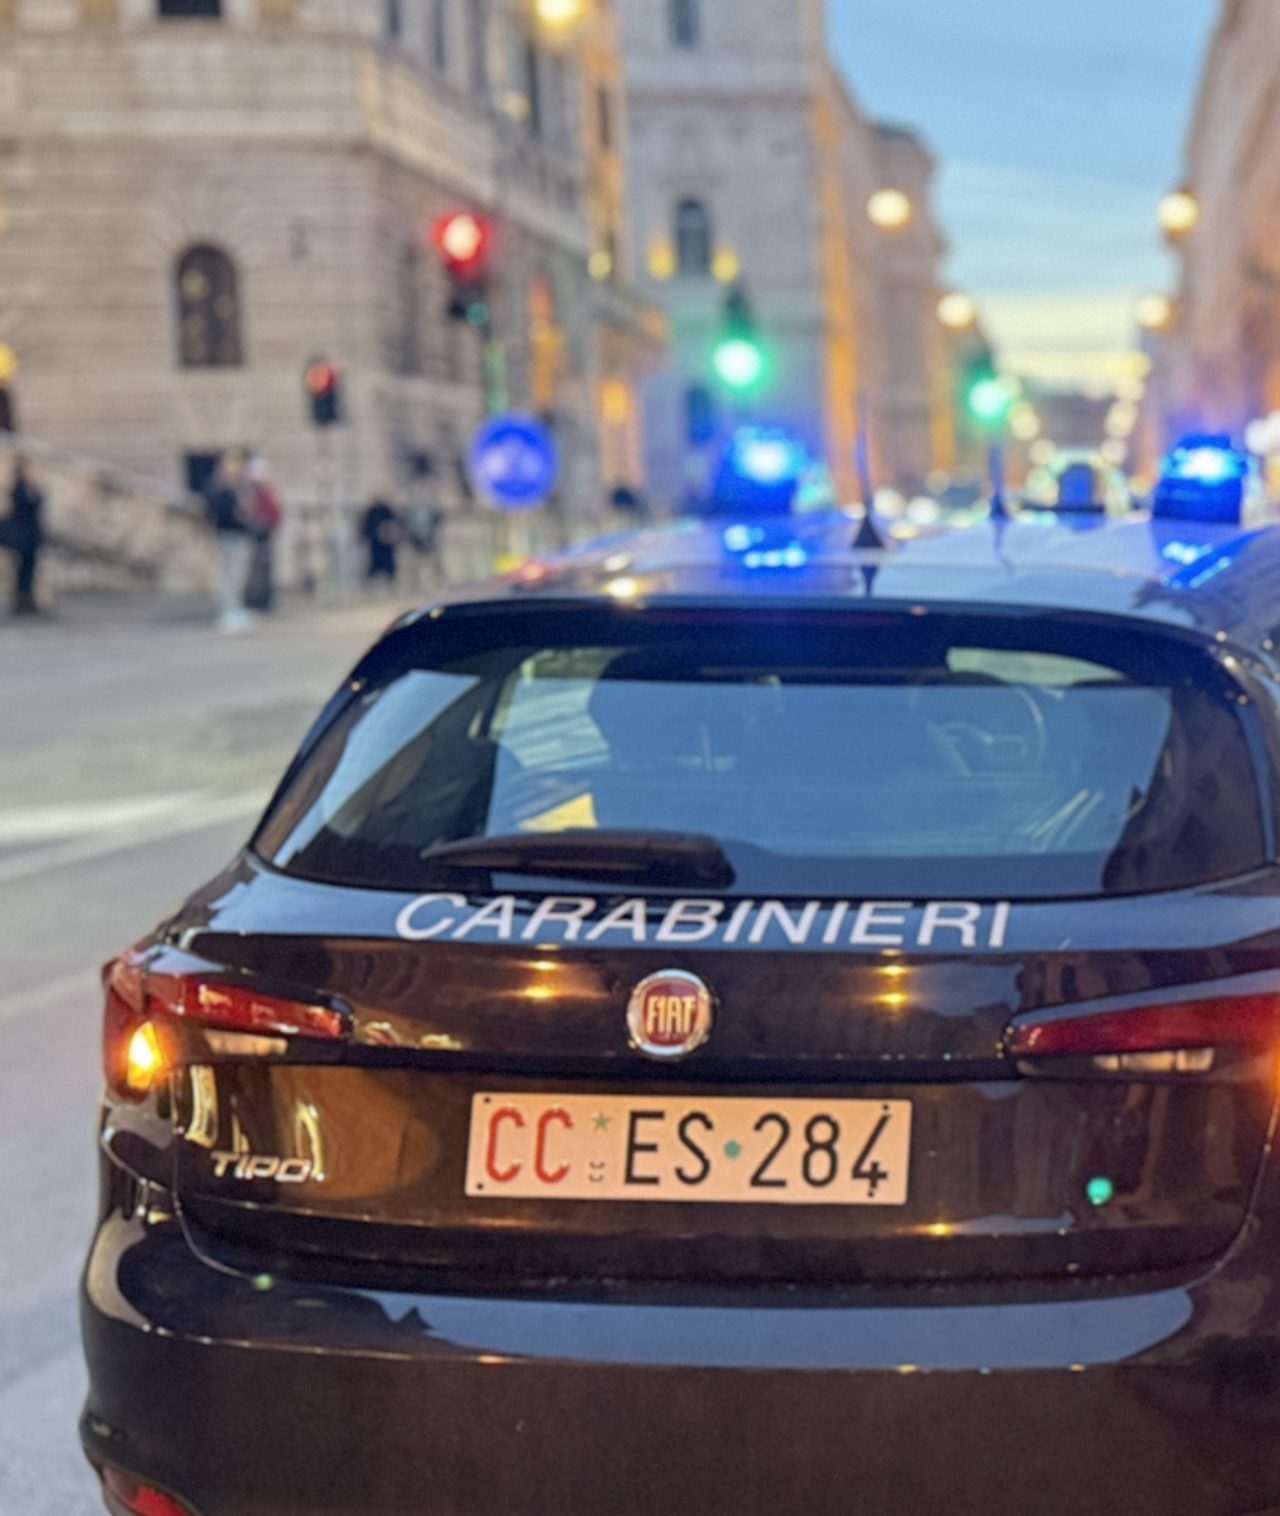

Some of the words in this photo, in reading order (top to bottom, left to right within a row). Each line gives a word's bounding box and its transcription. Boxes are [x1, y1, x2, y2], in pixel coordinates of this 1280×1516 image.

[394, 893, 1011, 947] CARABINIERI
[646, 995, 697, 1034] FIAT
[210, 1150, 312, 1182] TIPO
[485, 1107, 575, 1184] CC
[749, 1112, 893, 1190] 284
